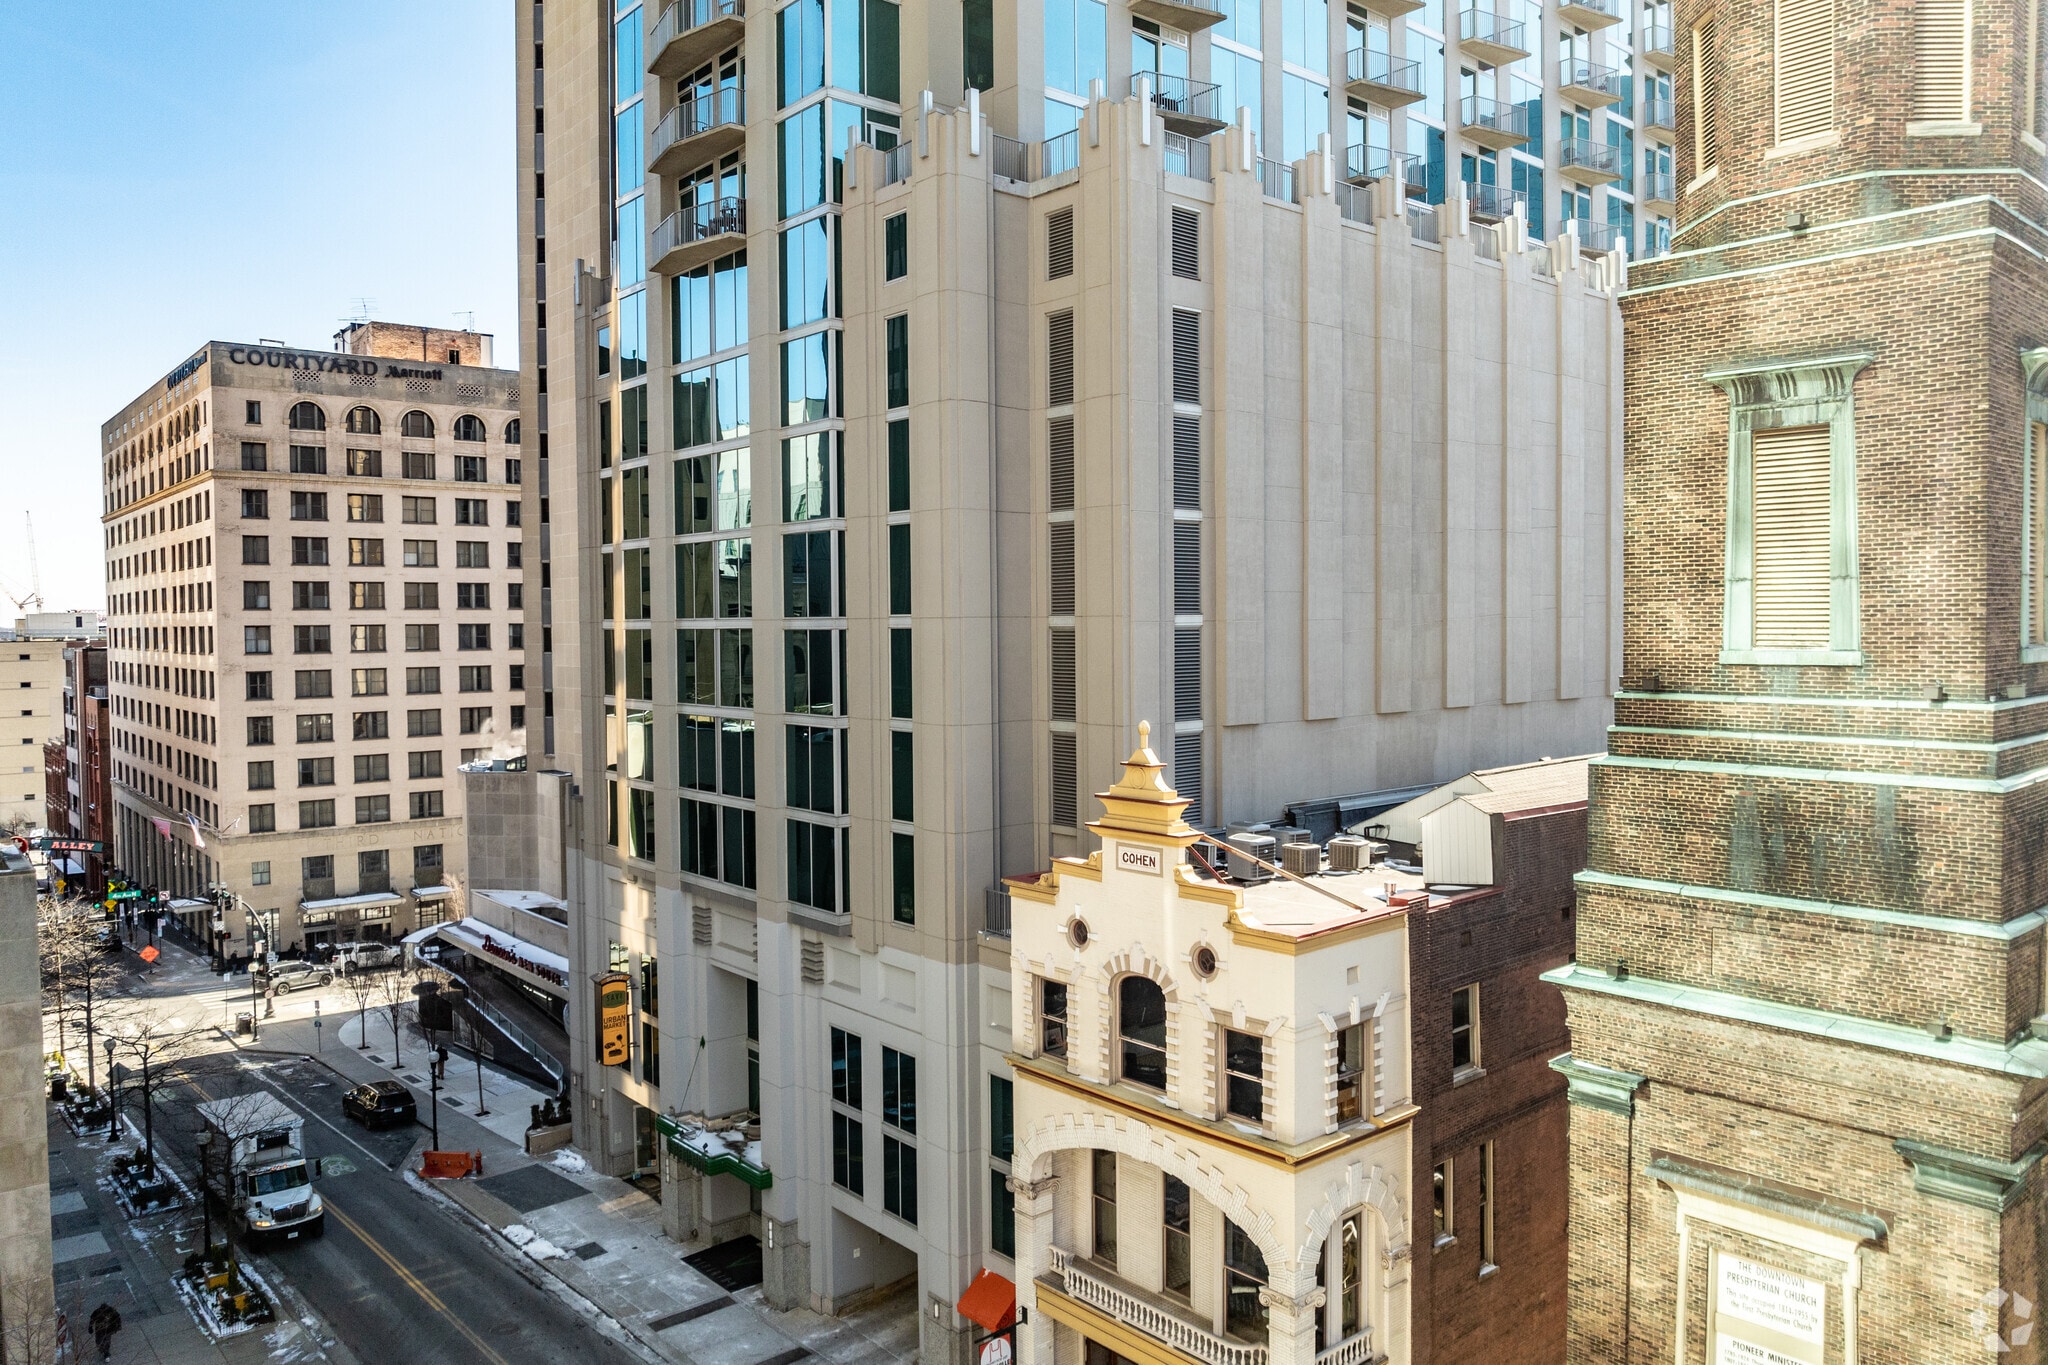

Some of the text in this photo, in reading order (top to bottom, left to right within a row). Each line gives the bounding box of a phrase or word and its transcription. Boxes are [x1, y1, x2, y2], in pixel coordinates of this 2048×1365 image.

[229, 349, 378, 376] COURTYARD
[385, 365, 443, 381] Marriott
[51, 841, 95, 851] ALLEY
[1122, 852, 1156, 868] COHEN
[603, 1014, 626, 1024] URBAN
[603, 1020, 626, 1030] MARKET
[1738, 1261, 1805, 1289] THE DOWNTOWN
[1726, 1271, 1817, 1307] PRESBYTERIAN CHURCH
[1793, 1319, 1813, 1332] Church
[1732, 1340, 1764, 1358] PIONEER
